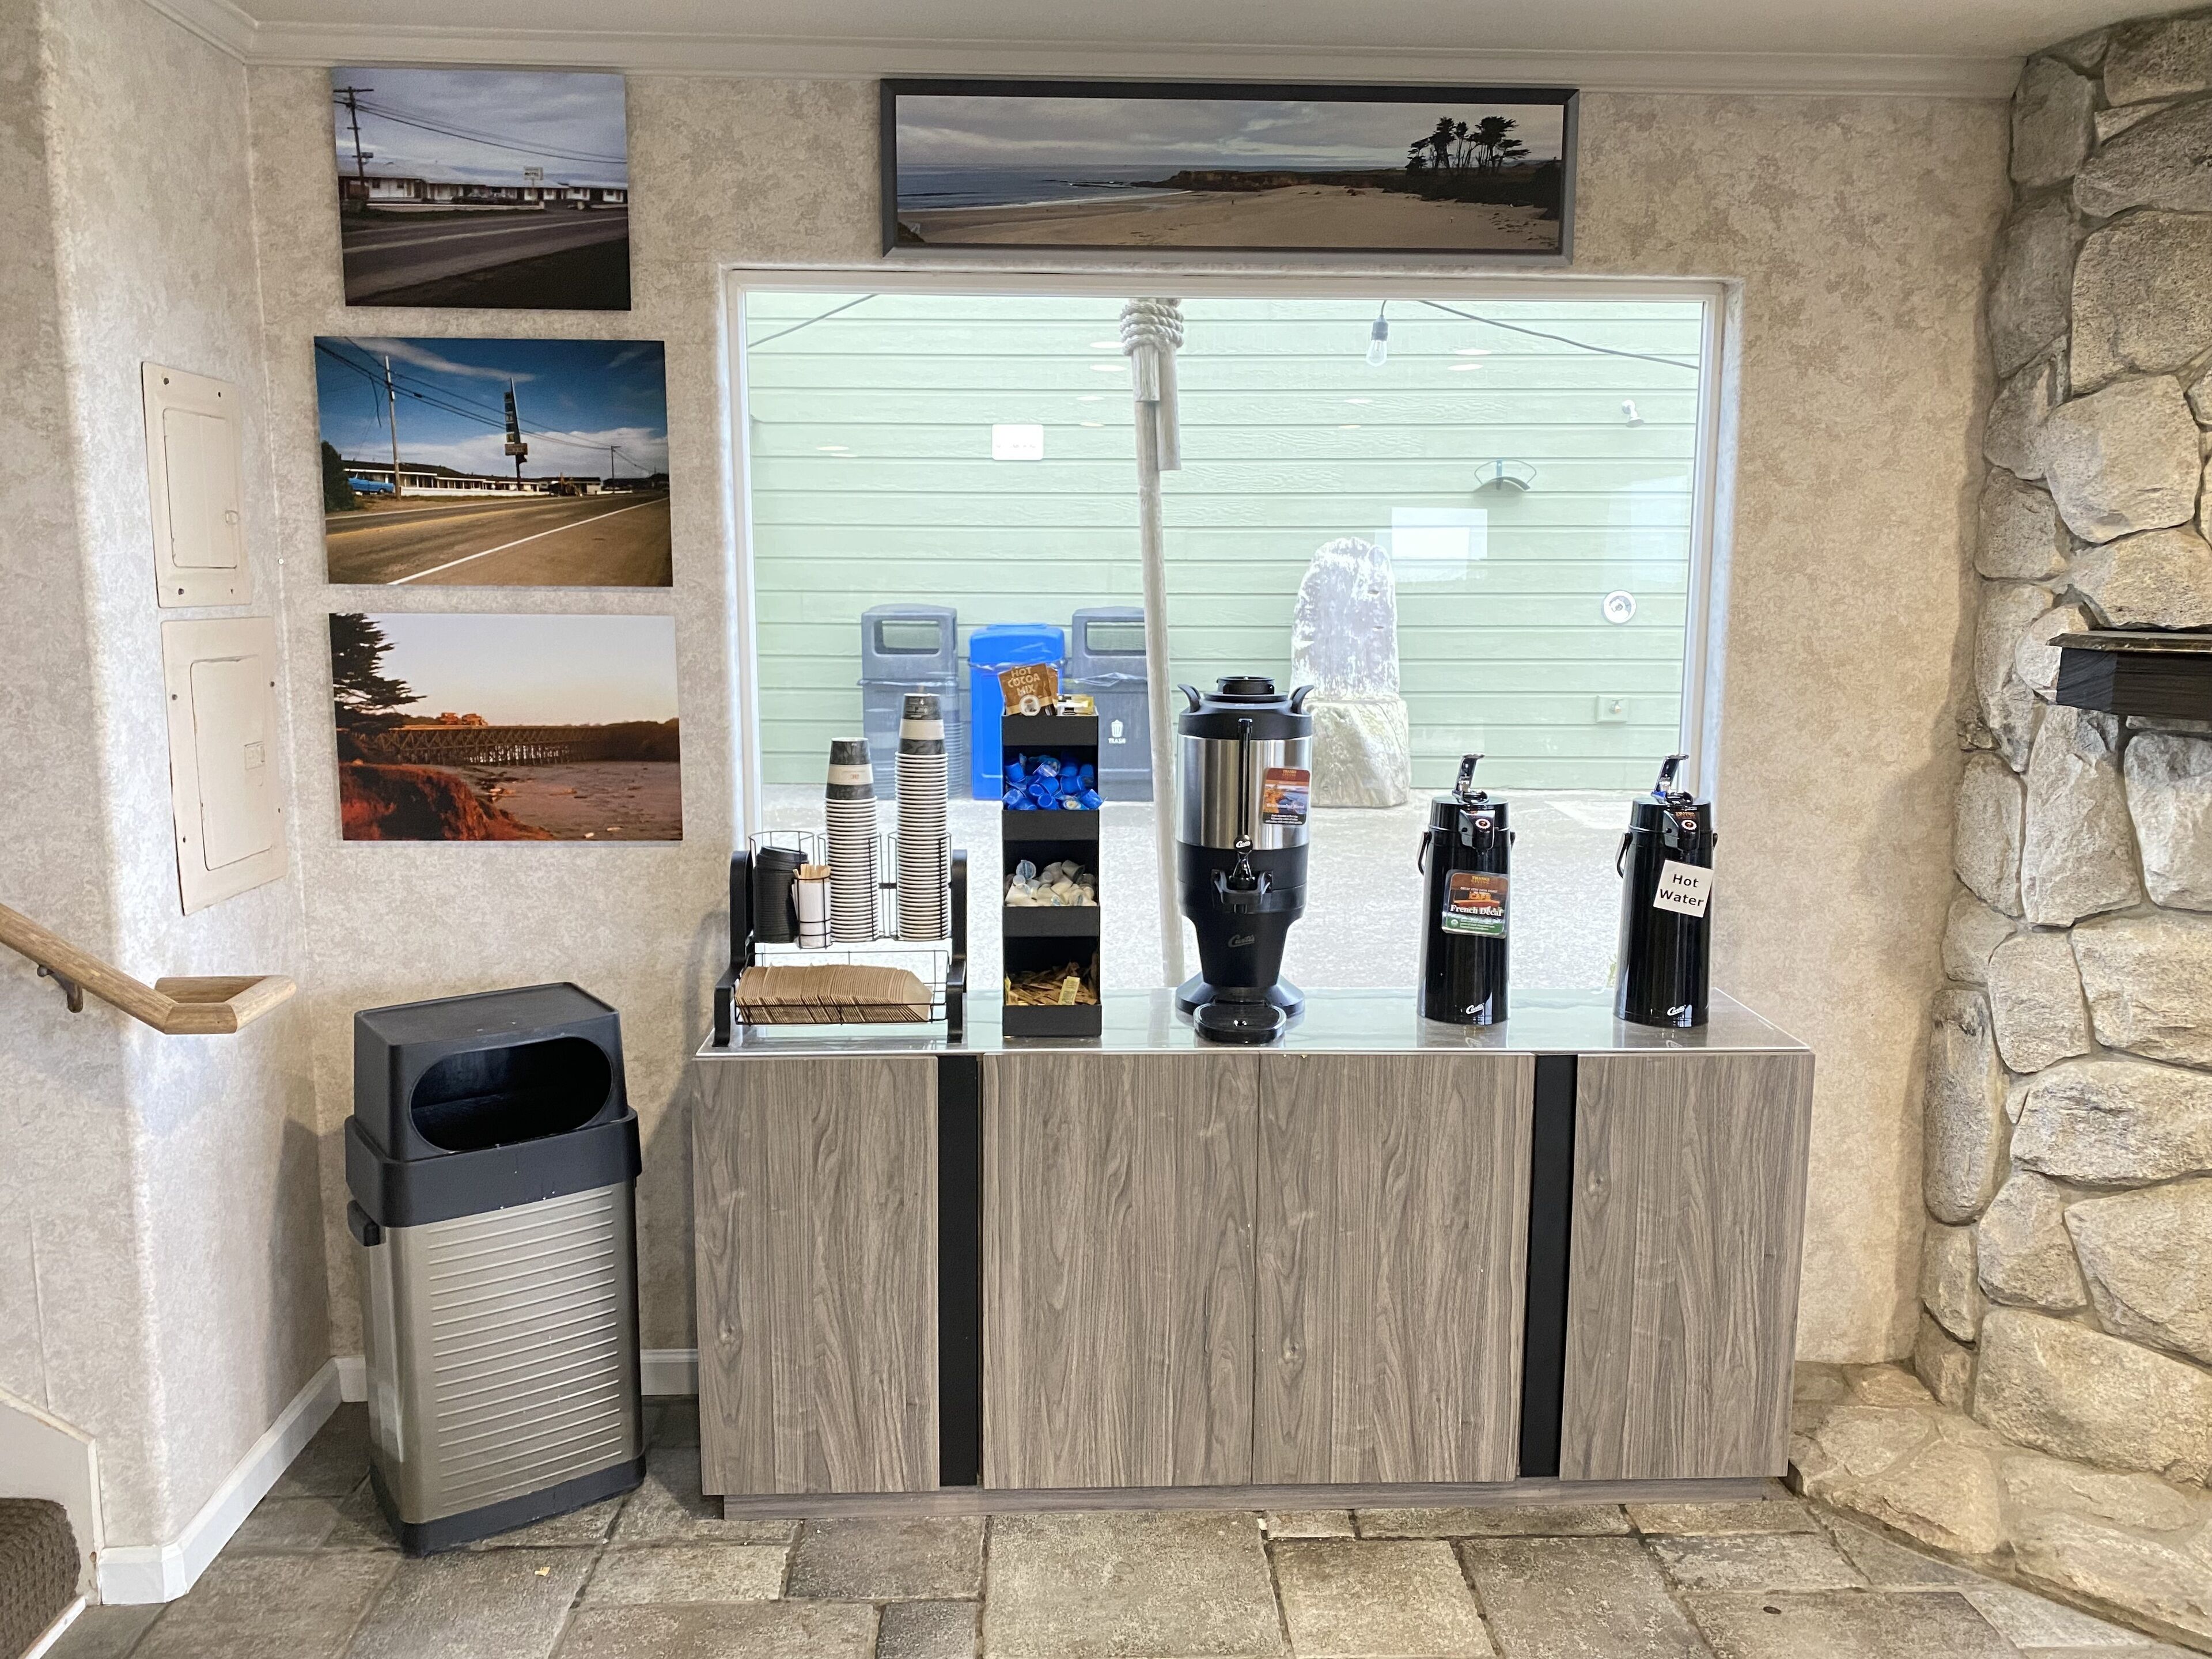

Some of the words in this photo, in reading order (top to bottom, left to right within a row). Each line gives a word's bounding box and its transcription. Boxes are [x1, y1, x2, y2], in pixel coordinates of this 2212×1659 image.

[1011, 666, 1032, 677] HOT
[1008, 673, 1040, 688] COCOA
[1016, 684, 1036, 695] MIX
[1672, 874, 1699, 888] Hot
[1660, 889, 1704, 906] Water
[1450, 904, 1478, 914] French
[1479, 906, 1503, 916] Decaf
[1228, 934, 1255, 948] Curtis
